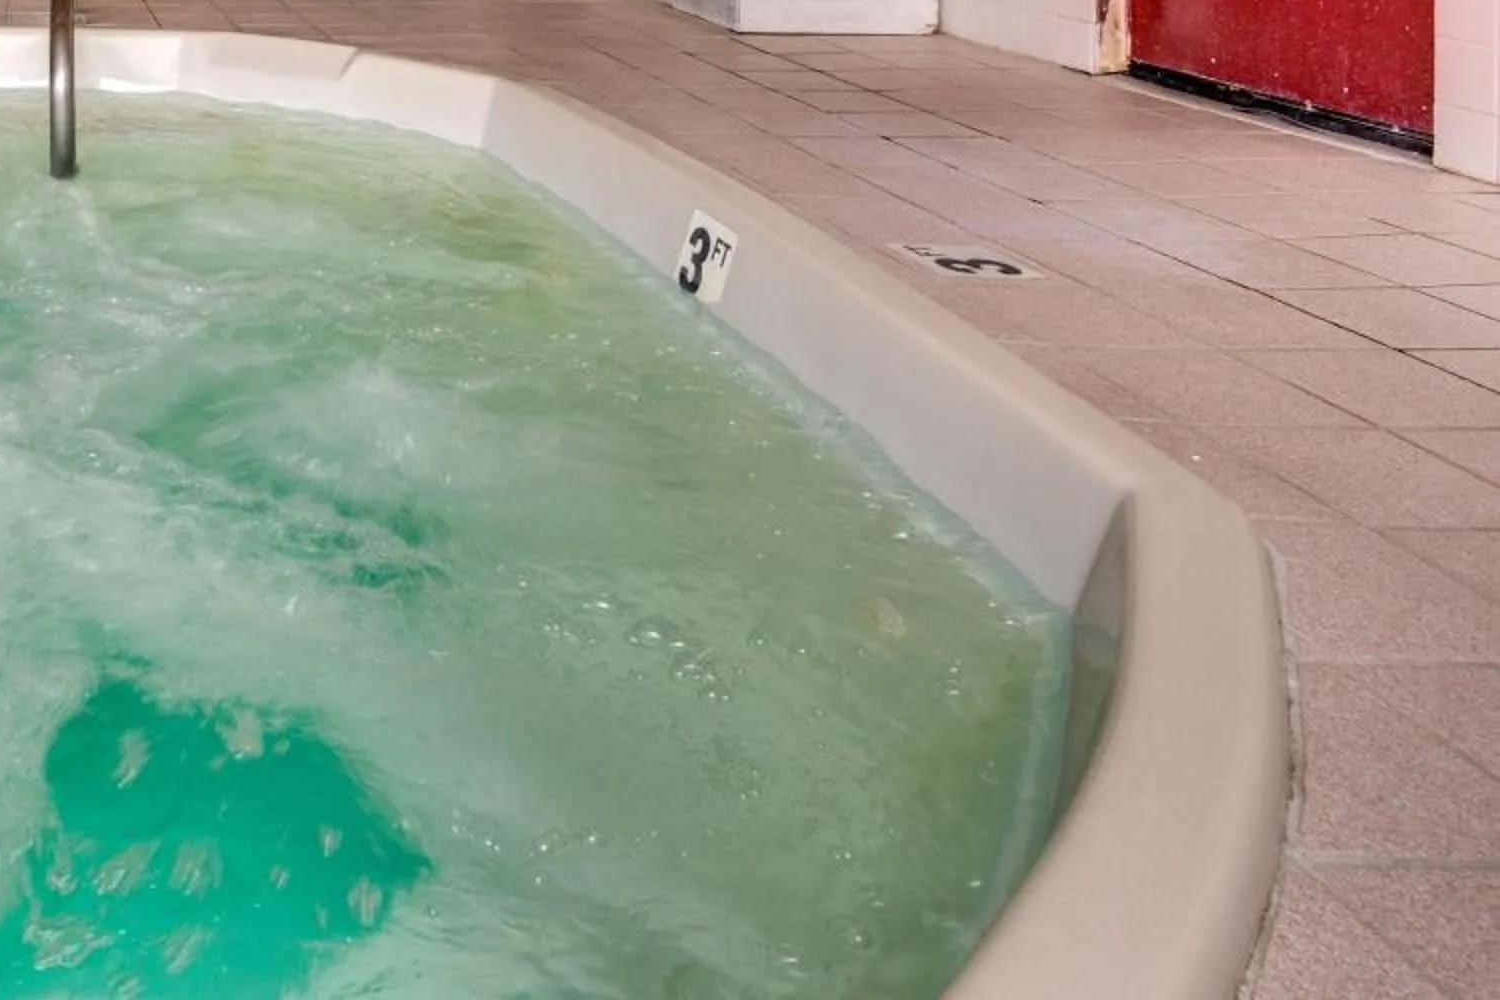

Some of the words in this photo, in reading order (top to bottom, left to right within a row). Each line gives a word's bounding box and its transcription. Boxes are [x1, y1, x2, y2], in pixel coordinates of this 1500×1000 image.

[679, 227, 711, 295] 3
[711, 237, 732, 268] FT
[934, 258, 1023, 275] 3
